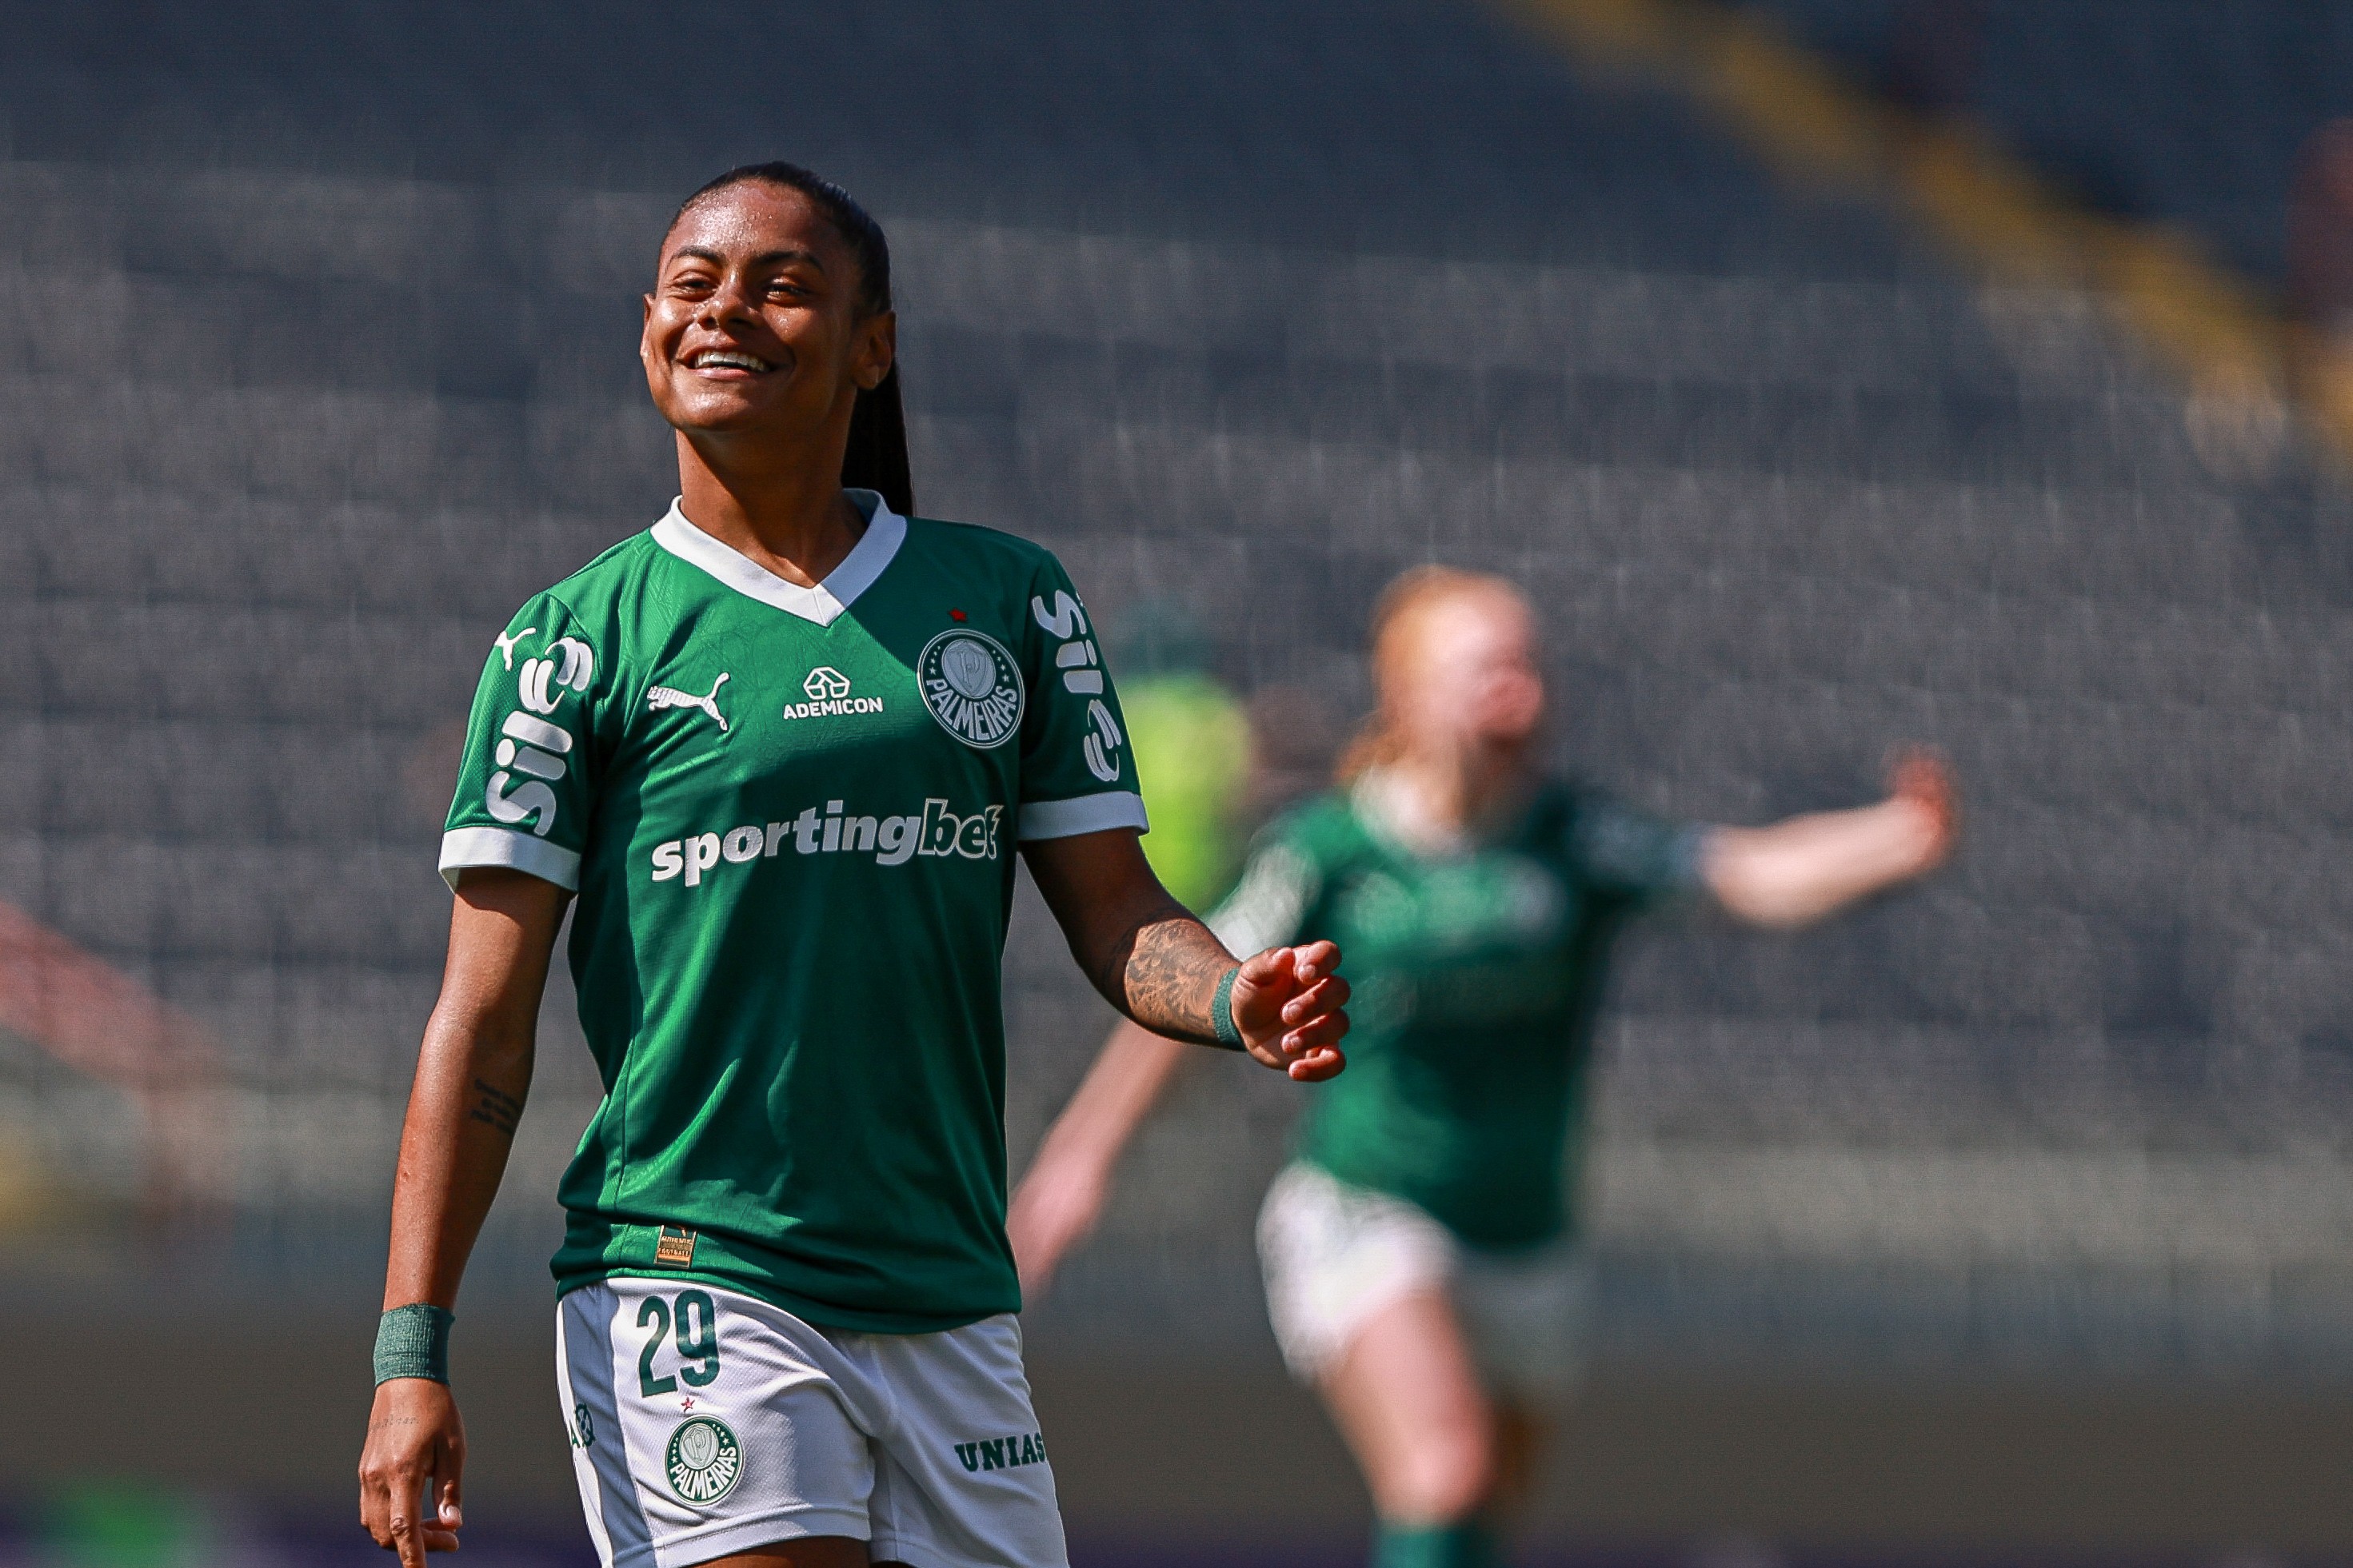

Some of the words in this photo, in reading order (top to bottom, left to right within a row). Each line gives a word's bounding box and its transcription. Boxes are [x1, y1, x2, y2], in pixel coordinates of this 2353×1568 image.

[783, 696, 884, 720] ADEMICON
[925, 678, 1017, 740] PALMEIRAS
[651, 797, 1005, 888] sportingbet
[635, 1289, 721, 1398] 29
[669, 1446, 737, 1500] PALMEIRAS
